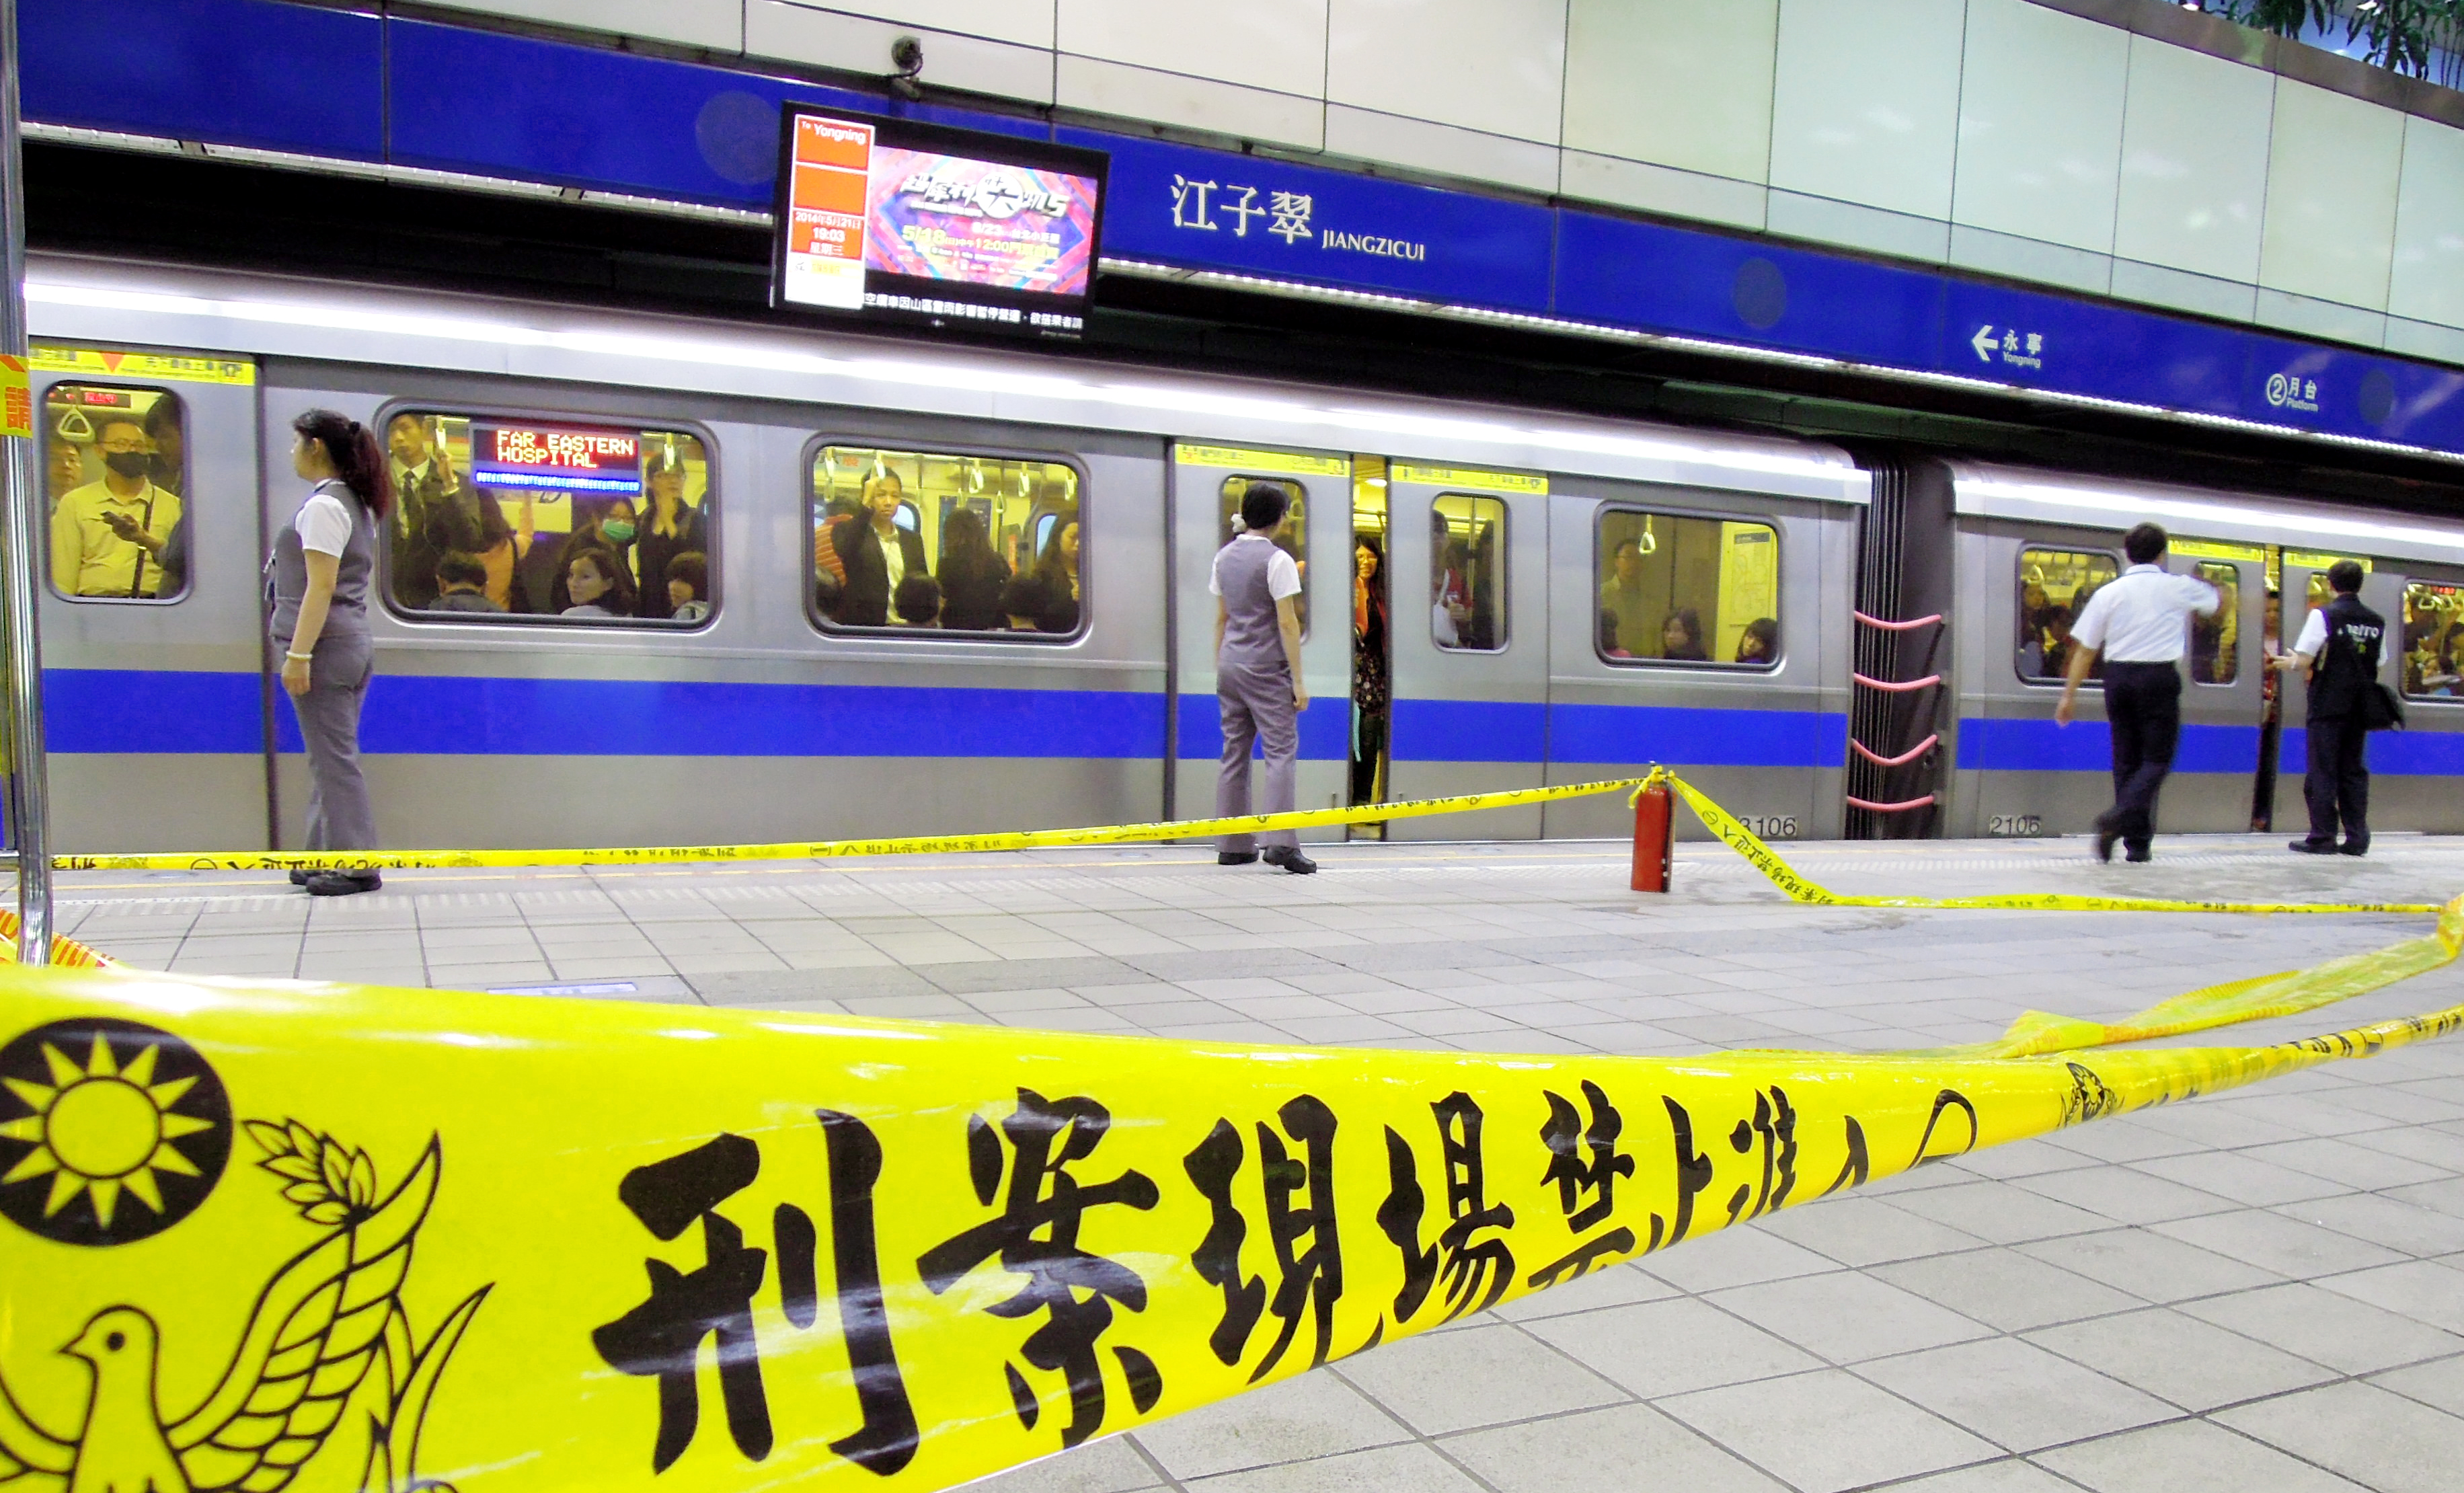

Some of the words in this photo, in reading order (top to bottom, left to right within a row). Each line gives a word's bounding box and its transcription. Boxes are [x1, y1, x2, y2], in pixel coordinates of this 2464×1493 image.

[814, 123, 866, 145] Yongning
[1171, 174, 1313, 244] 江子翠
[813, 226, 846, 242] 19:03
[1322, 229, 1426, 261] JIANGZICUI
[809, 241, 844, 256] 星期三
[2003, 350, 2041, 369] Yongning
[2288, 377, 2317, 399] 月台
[497, 429, 537, 448] FAR
[547, 433, 634, 456] EASTERN
[497, 446, 598, 469] HOSPITAL
